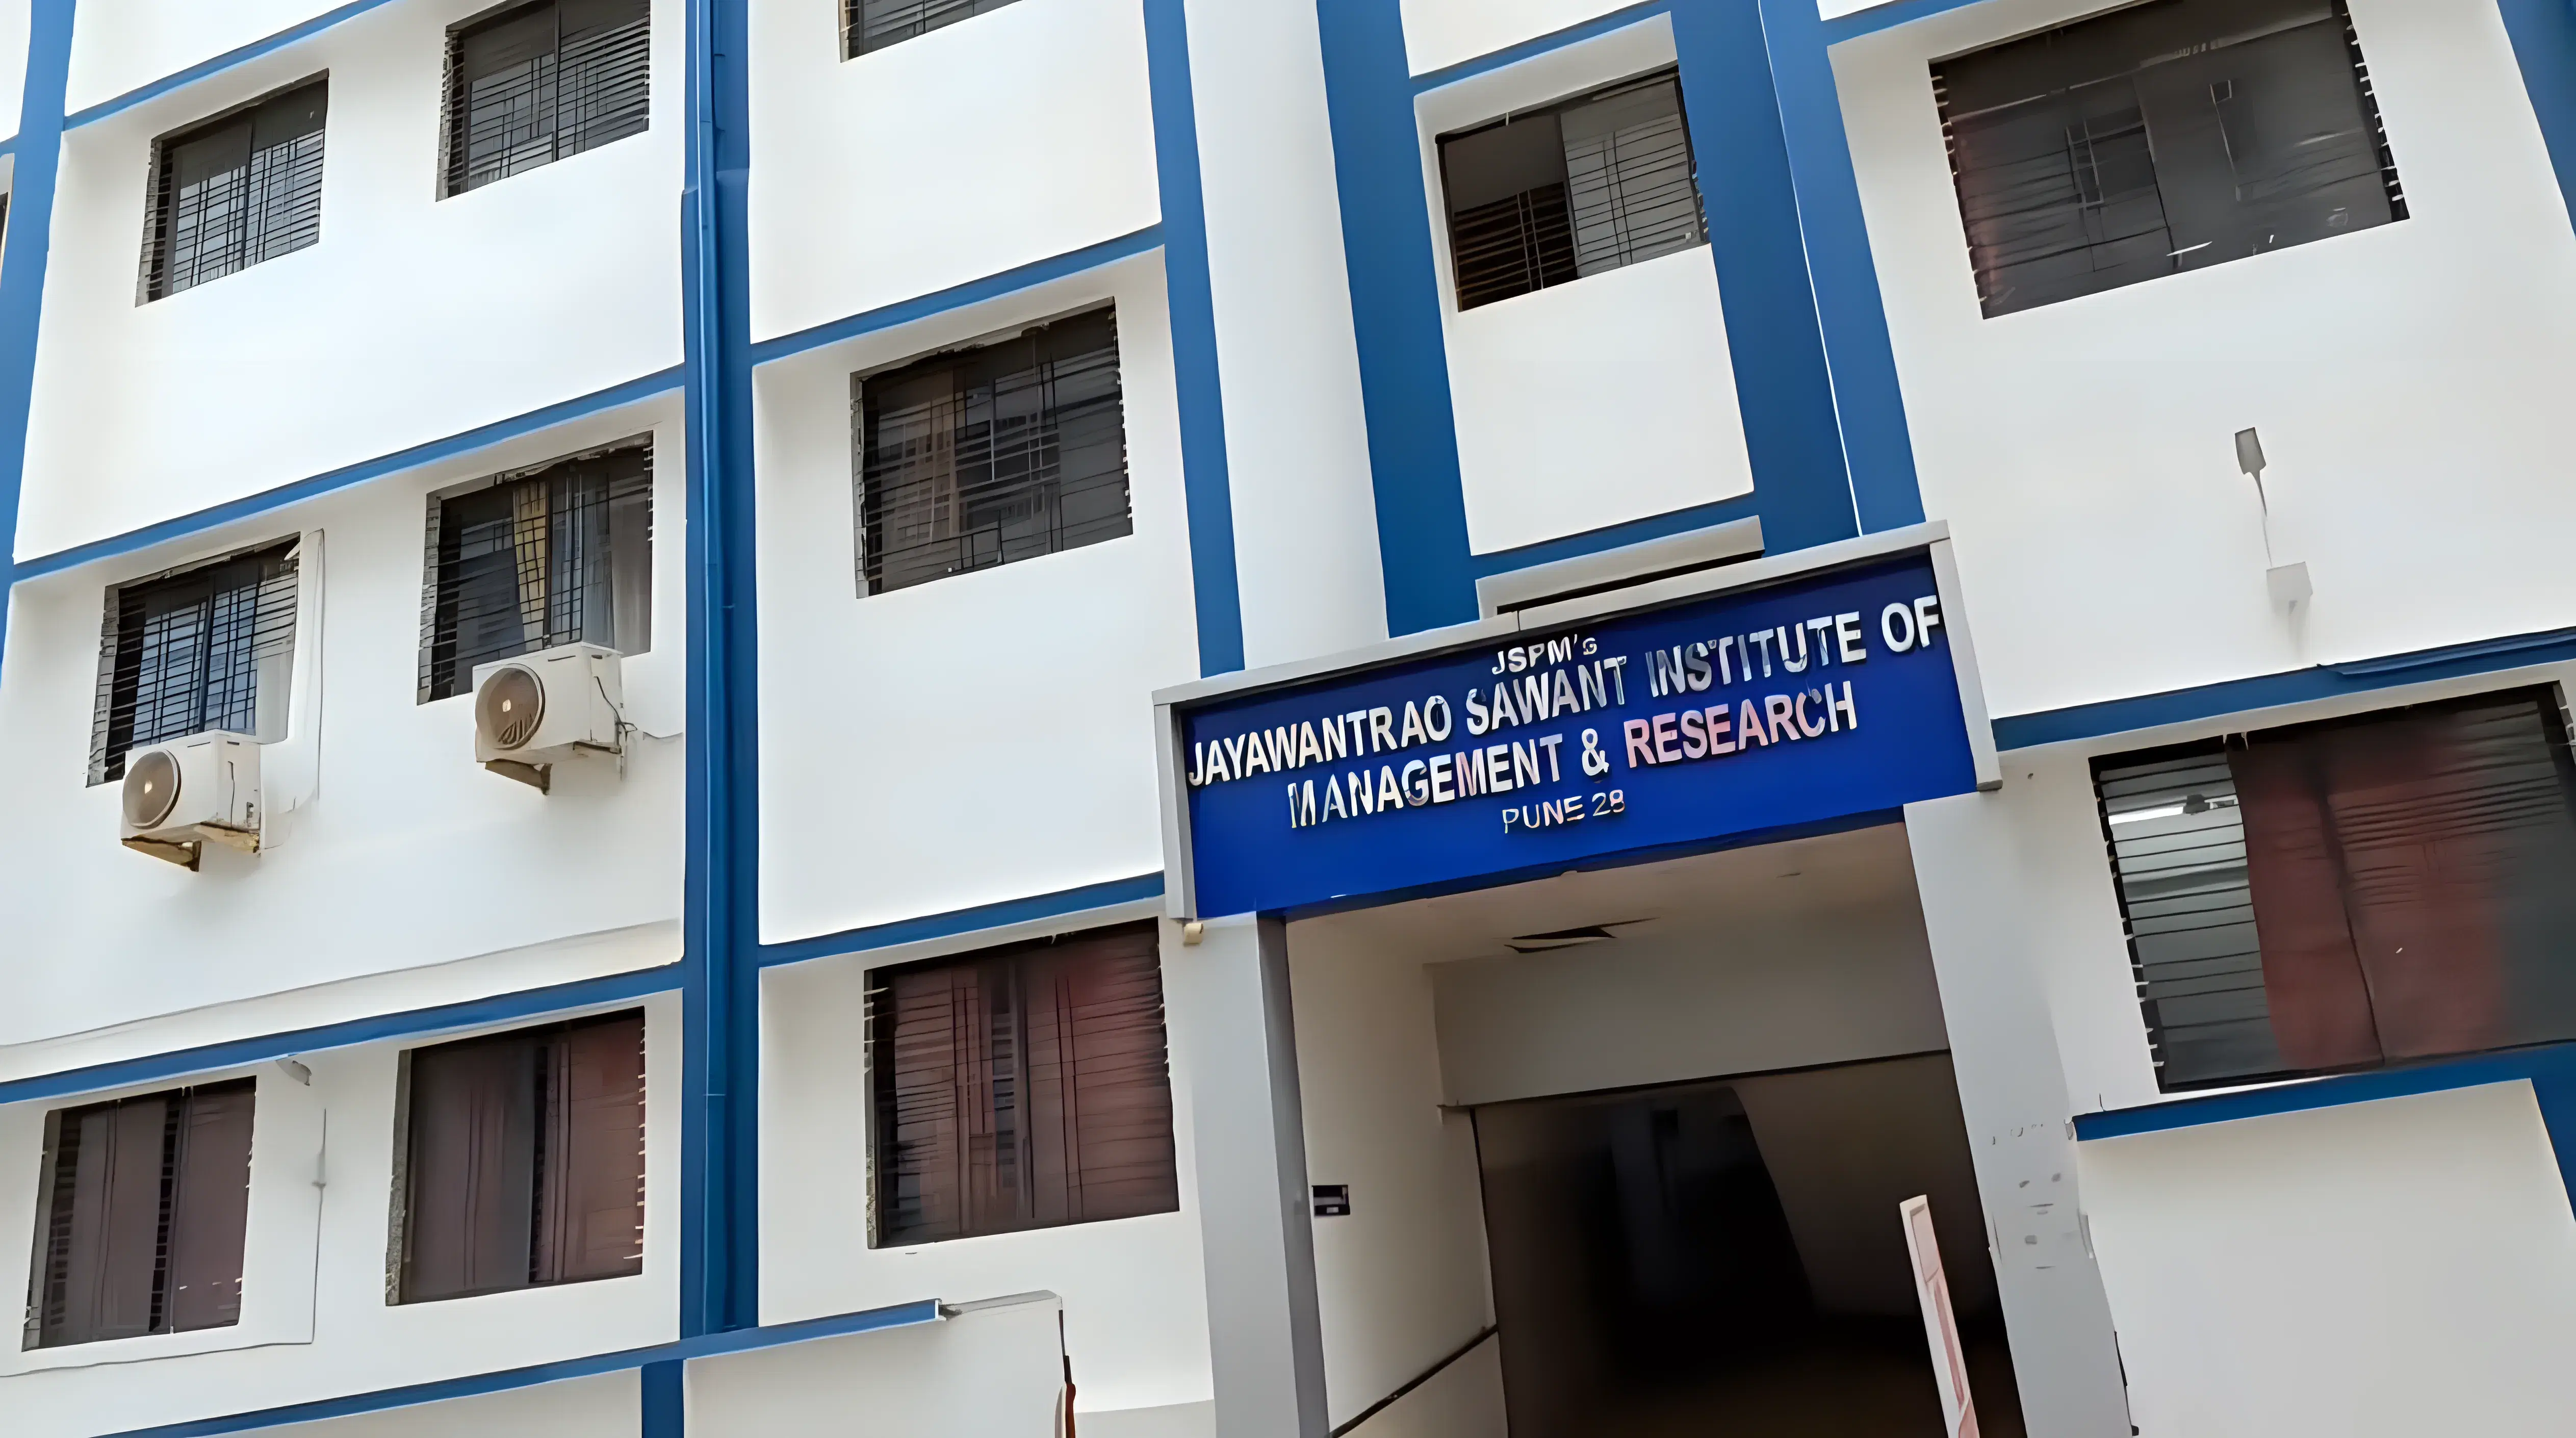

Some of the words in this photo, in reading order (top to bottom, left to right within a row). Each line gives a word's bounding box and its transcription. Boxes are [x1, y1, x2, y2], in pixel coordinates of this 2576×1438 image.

[1189, 695, 1452, 786] JAYAWANTRAO
[1465, 655, 1627, 735] SAWANT
[1645, 611, 1867, 698] INSTITUTE
[1881, 595, 1939, 653] OF
[1287, 733, 1563, 829] MANAGEMENT
[1581, 728, 1609, 776] &
[1623, 680, 1858, 768] RESEARCH
[1502, 795, 1585, 834] PUNE
[1592, 789, 1626, 817] 28
